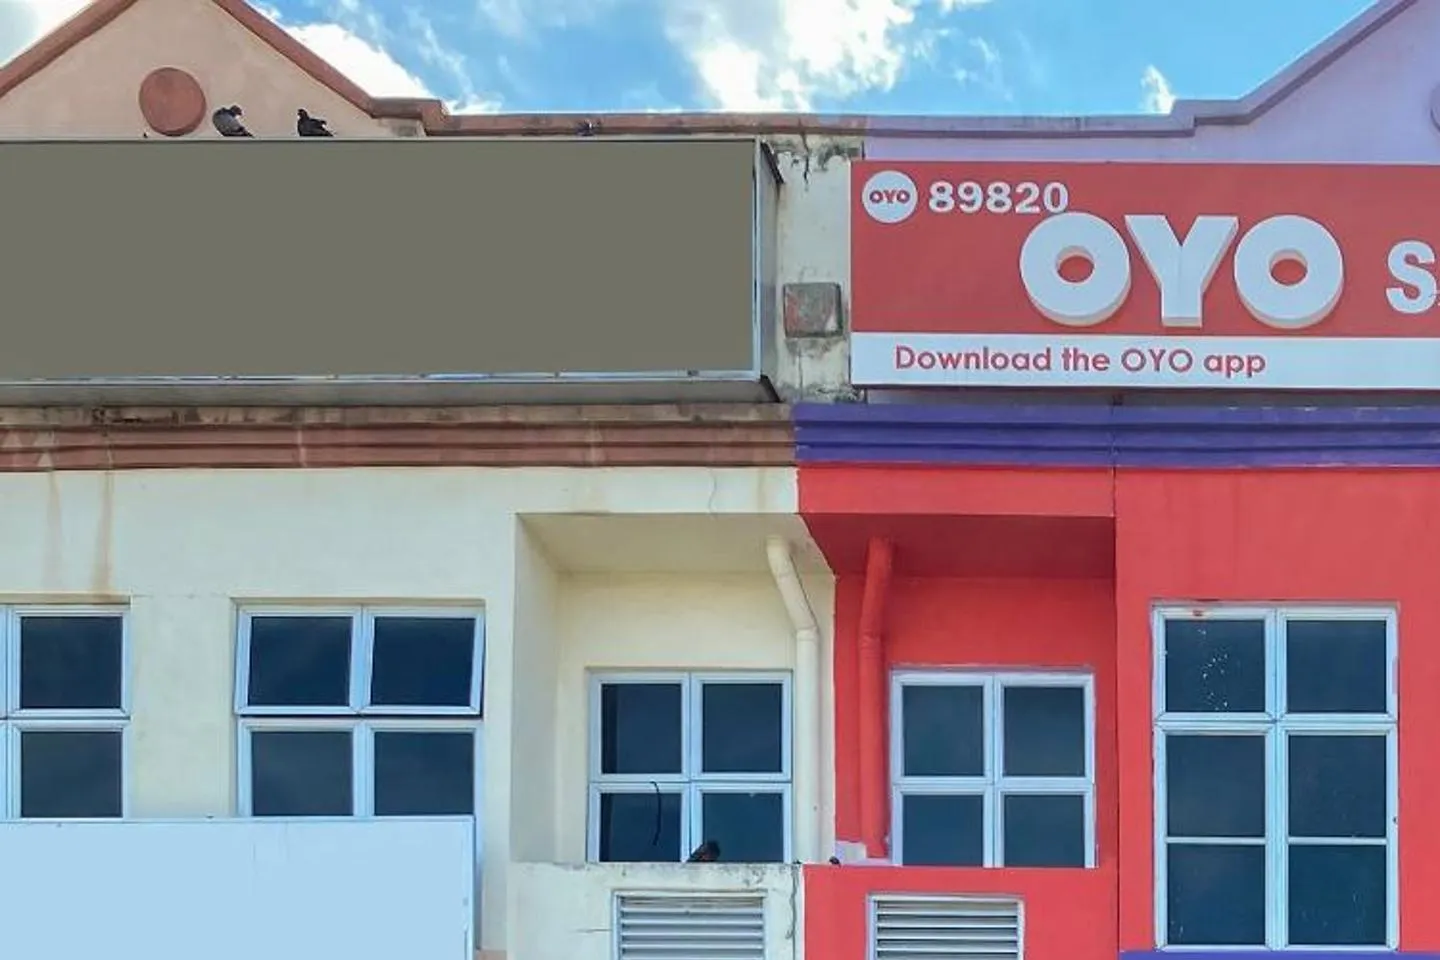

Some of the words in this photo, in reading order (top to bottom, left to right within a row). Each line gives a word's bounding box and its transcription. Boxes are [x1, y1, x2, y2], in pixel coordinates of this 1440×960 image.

[868, 187, 911, 205] OYO
[928, 180, 1069, 214] 89820
[1019, 211, 1345, 329] OYO
[894, 345, 1053, 372] Download
[1060, 346, 1111, 372] the
[1121, 347, 1194, 373] OYO
[1203, 353, 1267, 378] app
